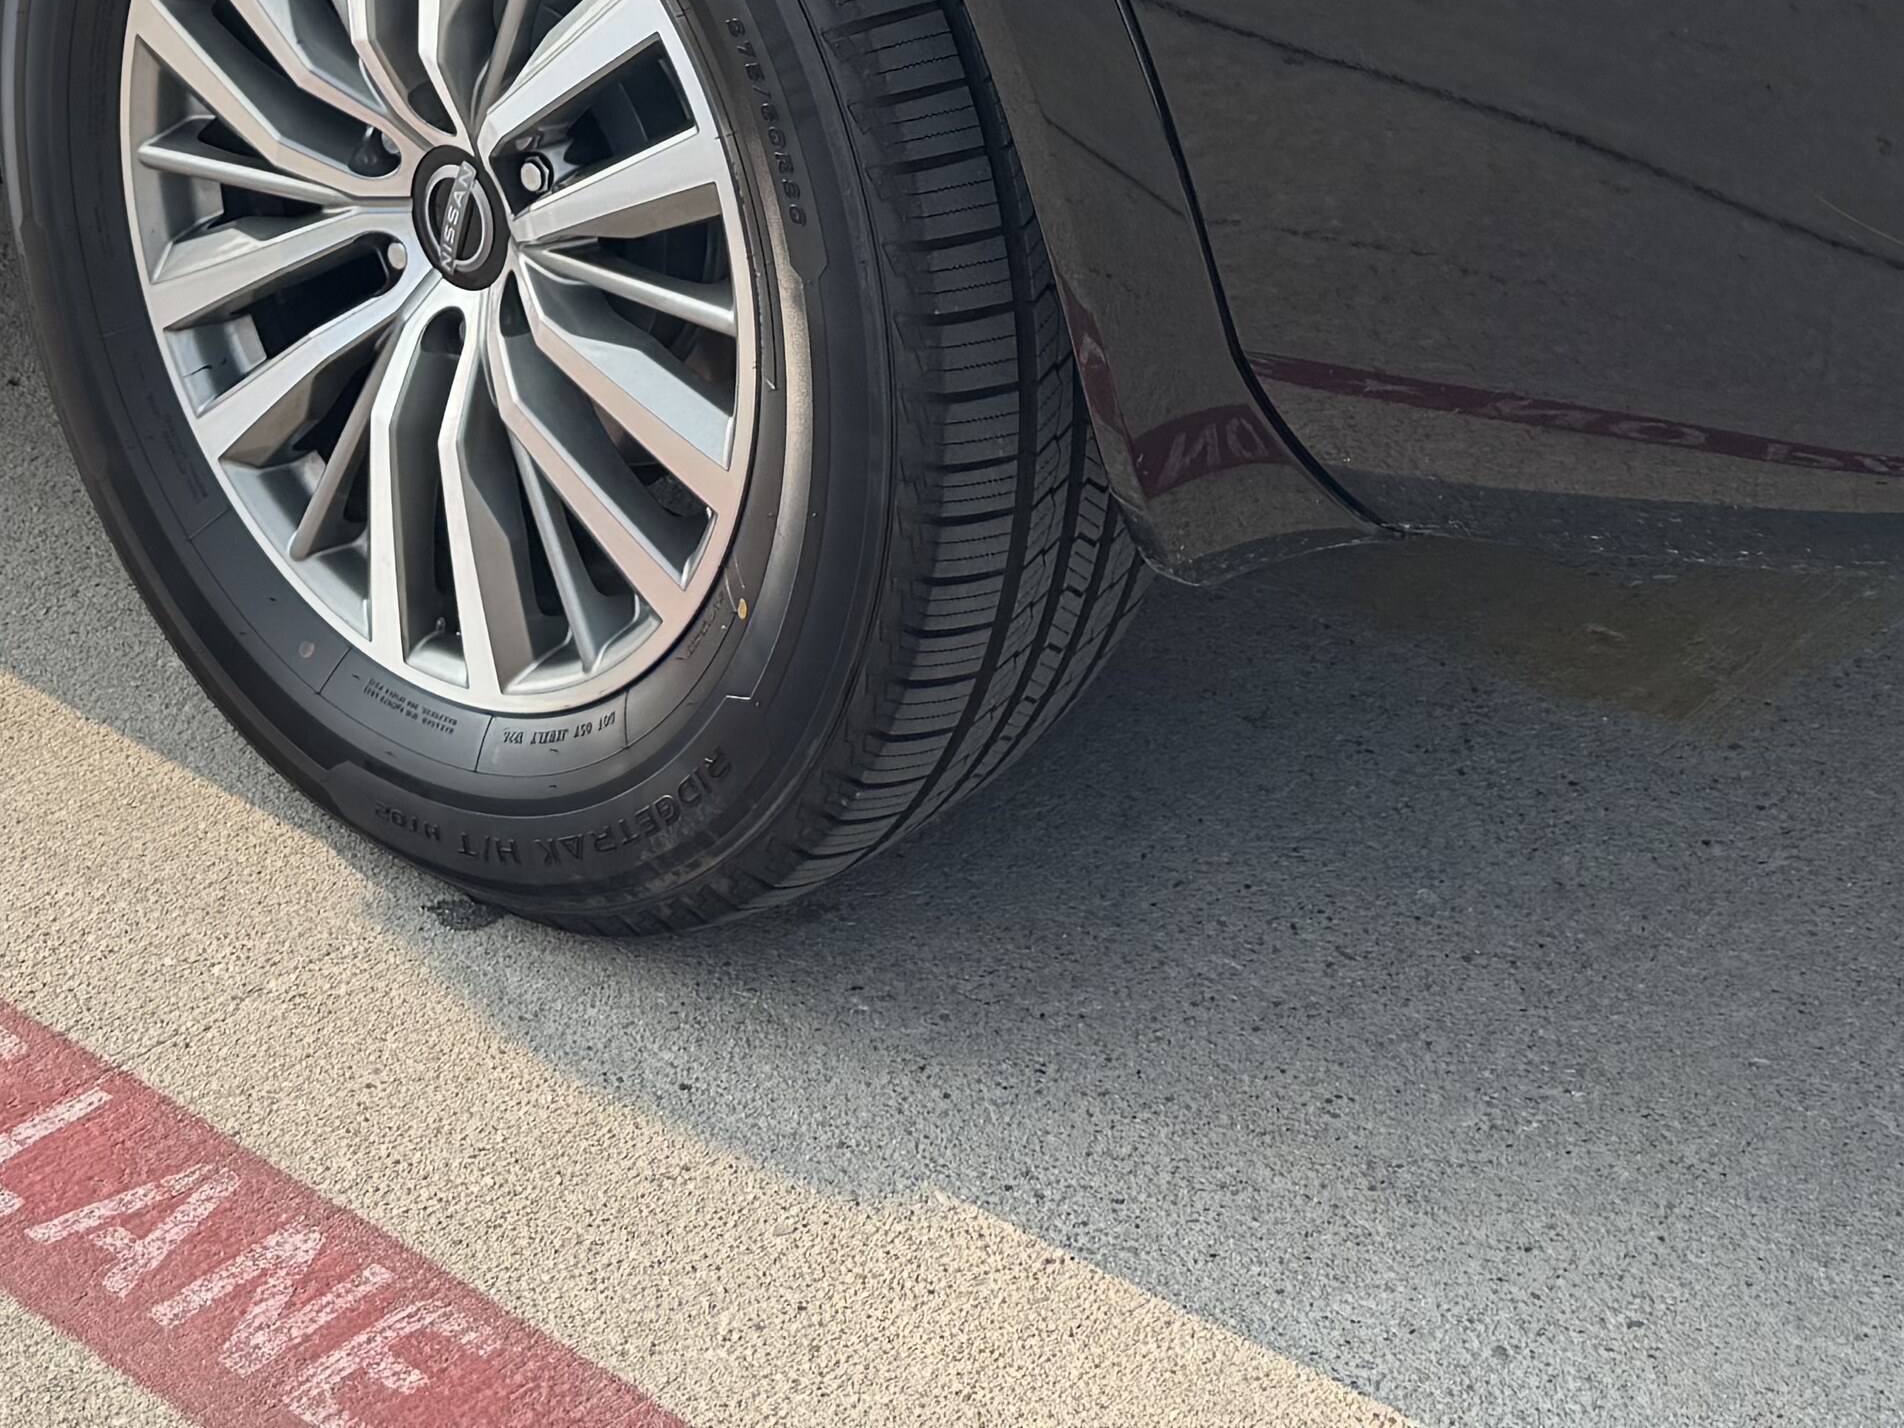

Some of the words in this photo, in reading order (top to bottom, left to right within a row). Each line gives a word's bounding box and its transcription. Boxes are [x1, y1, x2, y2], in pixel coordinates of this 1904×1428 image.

[441, 165, 475, 272] NISSAN
[456, 831, 522, 867] H/T
[532, 747, 733, 868] RIDGETRAK
